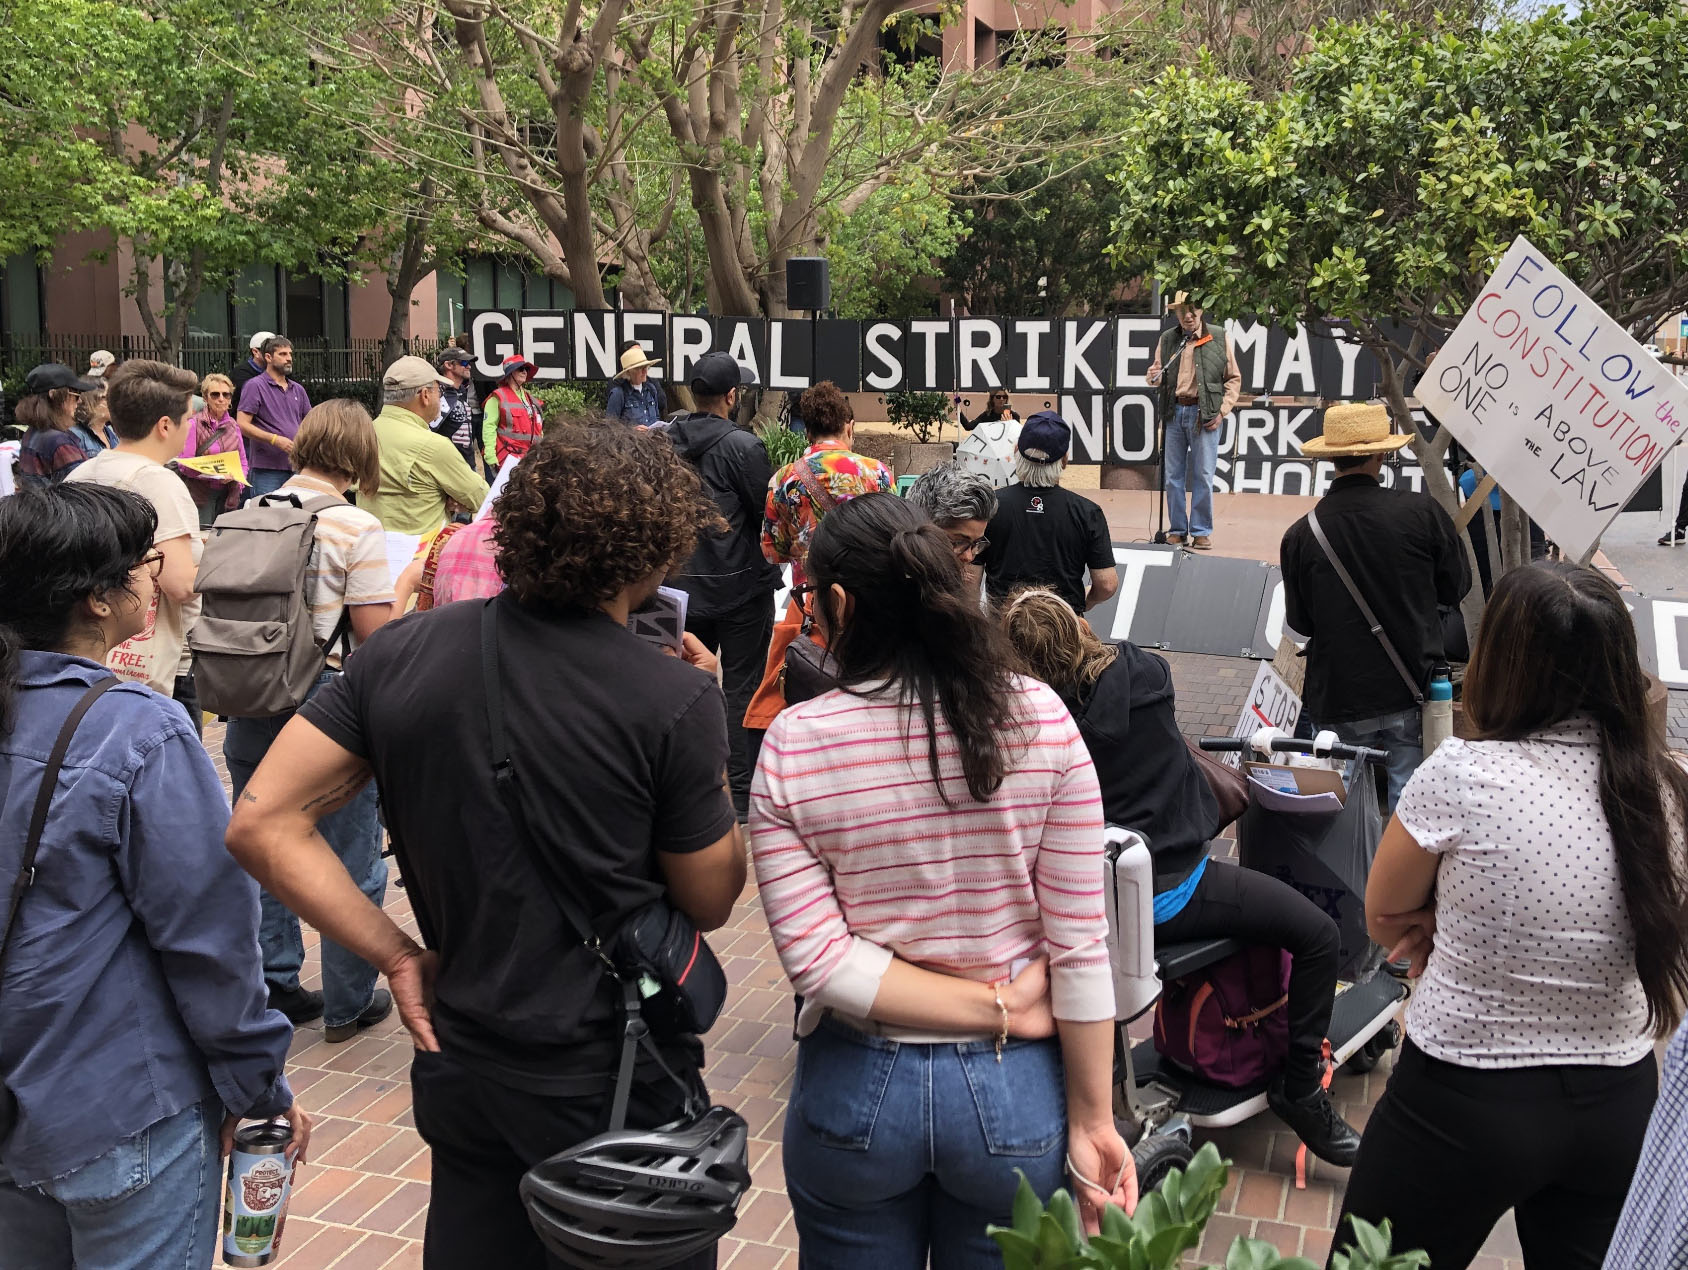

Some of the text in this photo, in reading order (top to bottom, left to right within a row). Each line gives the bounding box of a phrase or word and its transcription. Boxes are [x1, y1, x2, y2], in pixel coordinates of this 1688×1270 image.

[471, 311, 1363, 397] GENERAL STRIKE MAY
[1462, 341, 1509, 389] NO
[1505, 255, 1681, 433] FOLLOW the
[1440, 365, 1496, 425] ONE
[1477, 293, 1663, 475] CONSTITUTION
[1062, 395, 1155, 462] NO
[1535, 404, 1620, 486] ABOVE
[1525, 438, 1619, 512] THE LAW
[111, 650, 146, 668] FREE.
[1254, 675, 1298, 732] STOP
